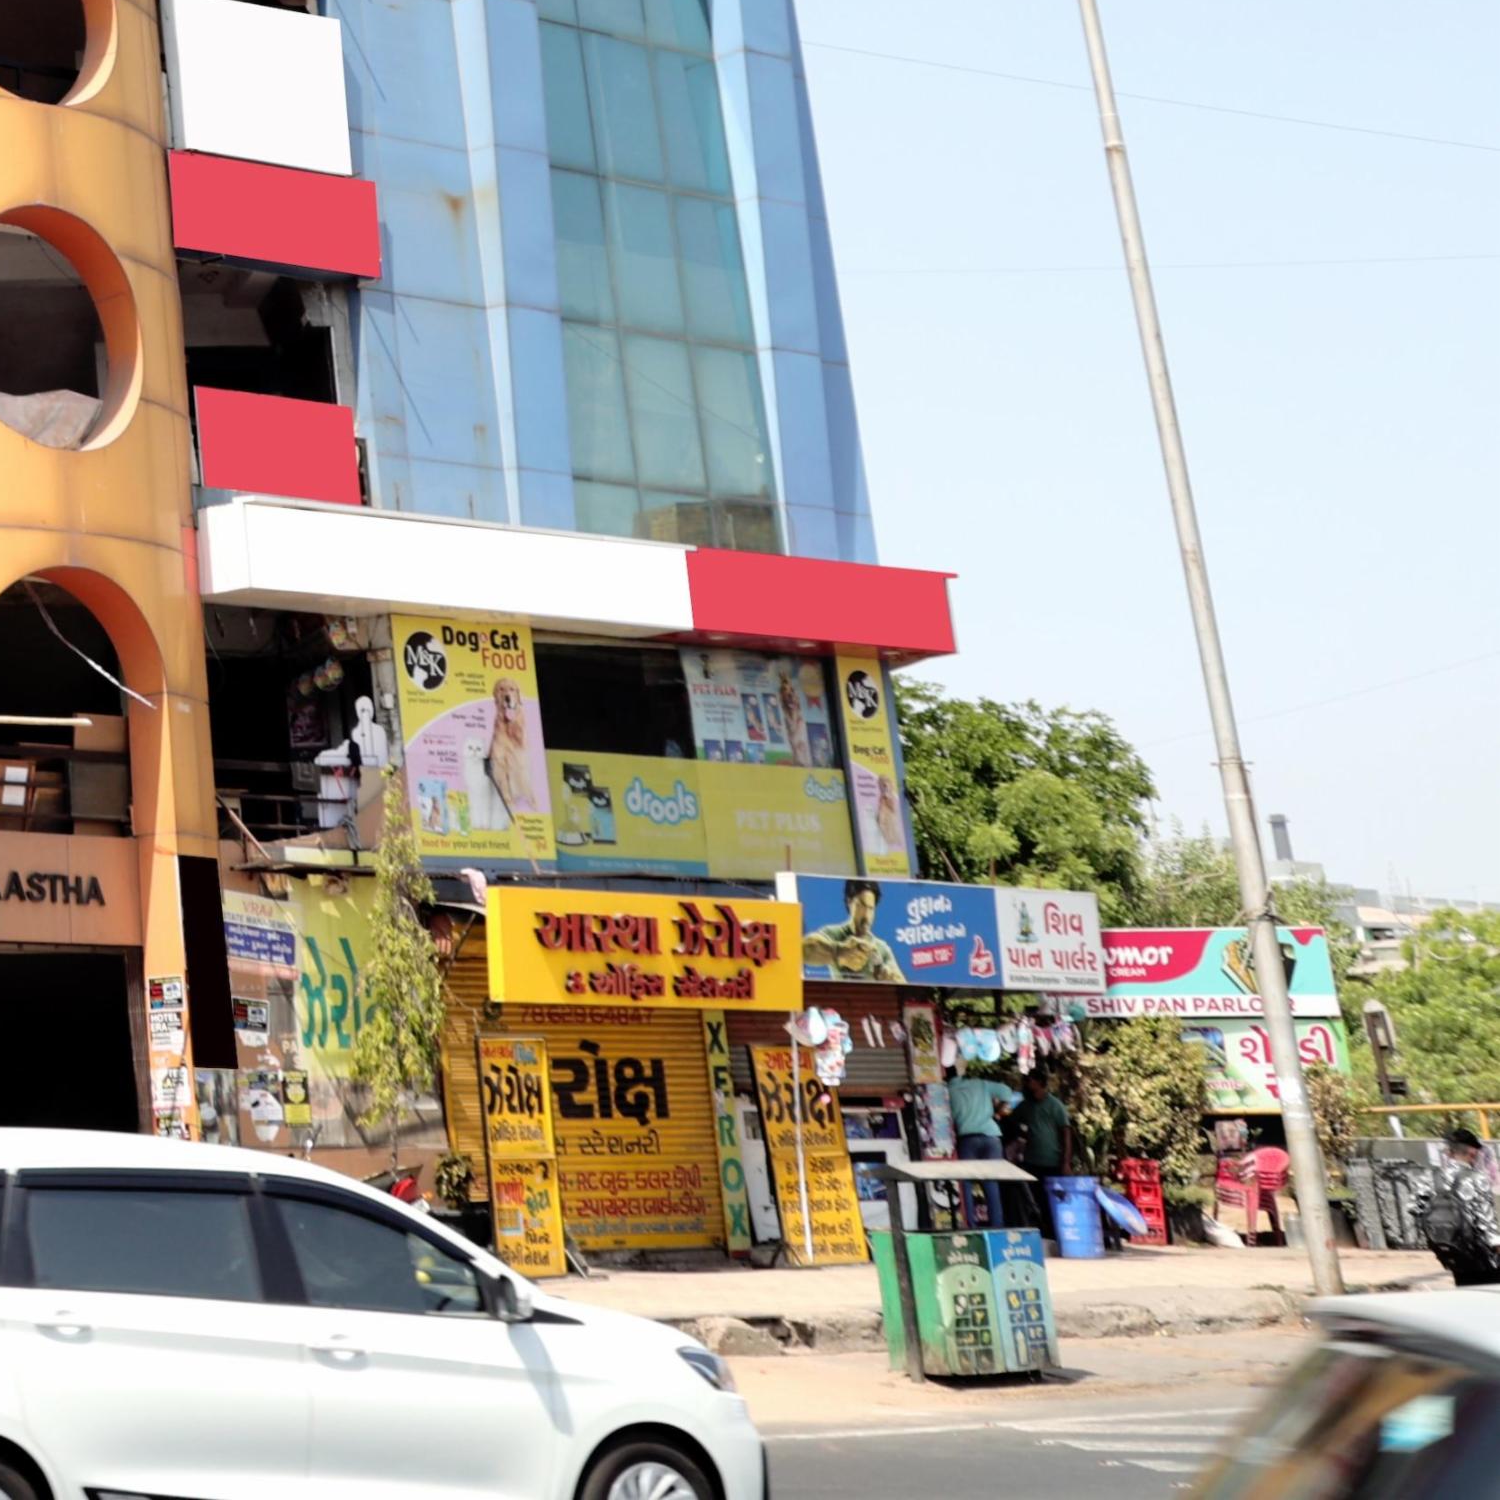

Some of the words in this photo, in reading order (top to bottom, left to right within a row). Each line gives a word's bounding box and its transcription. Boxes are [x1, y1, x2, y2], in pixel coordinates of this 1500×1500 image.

[441, 625, 480, 652] Dog
[490, 629, 519, 650] Cat
[481, 647, 527, 671] Food
[625, 776, 699, 824] drools
[735, 809, 771, 830] PET
[774, 811, 823, 832] PLUS
[422, 838, 440, 848] food
[441, 838, 450, 848] for
[452, 840, 469, 850] your
[1043, 900, 1085, 937] શિવ
[533, 911, 662, 955] આસ્થા
[671, 901, 780, 967] ઝેરોક્ષ
[1006, 946, 1044, 970] પાન
[1050, 941, 1099, 972] પાર્લર
[1109, 966, 1147, 978] CREAM
[150, 1013, 180, 1022] HOTEL
[1087, 998, 1137, 1014] SHIV
[1143, 997, 1188, 1013] PAN
[706, 1021, 748, 1237] XEROX
[576, 1171, 598, 1190] RC
